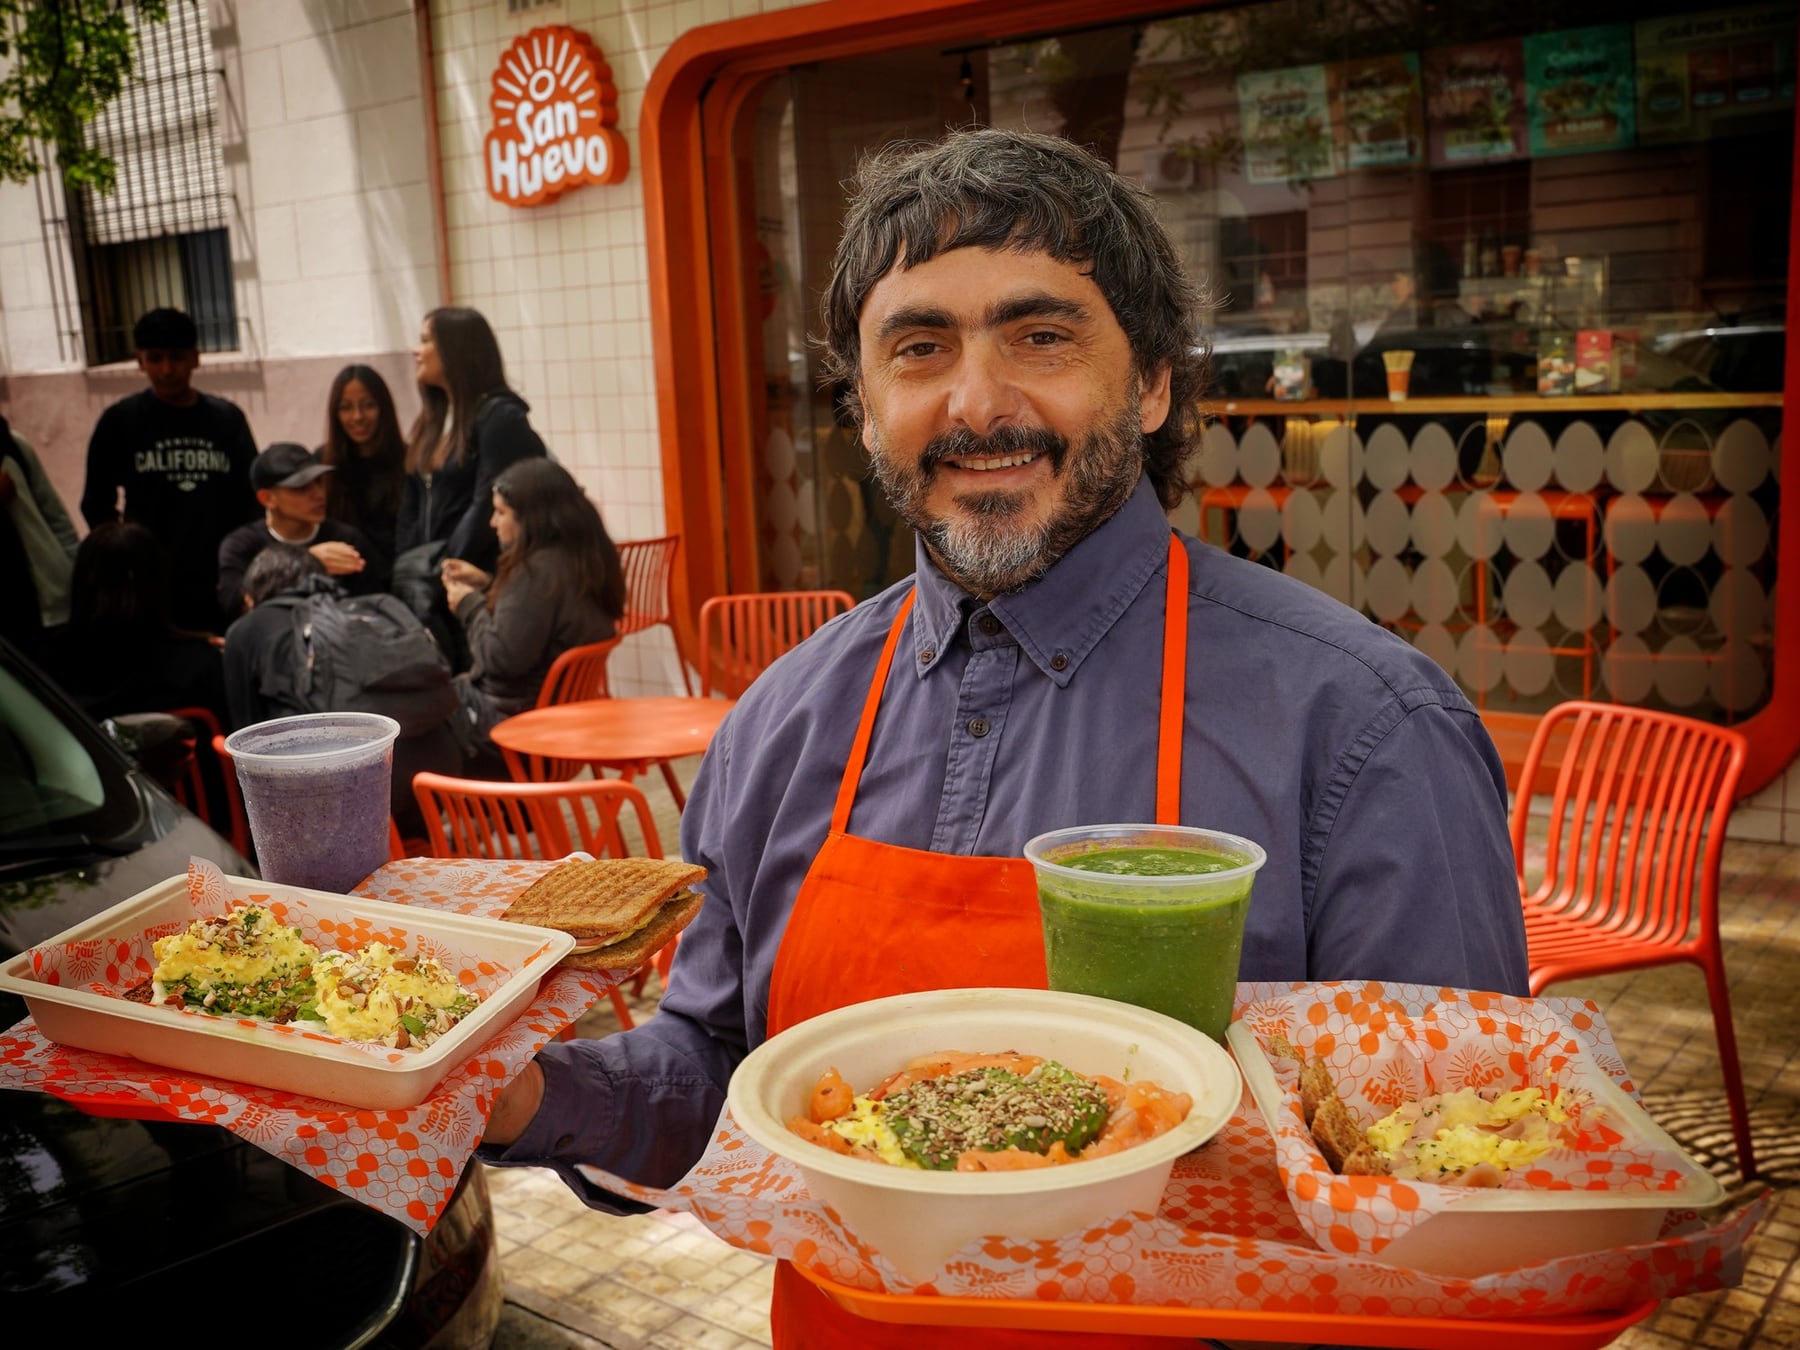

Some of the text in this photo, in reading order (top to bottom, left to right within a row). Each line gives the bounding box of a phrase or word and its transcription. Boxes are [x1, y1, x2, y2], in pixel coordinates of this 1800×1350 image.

[516, 100, 578, 156] San
[490, 135, 608, 199] Huevo
[1169, 1172, 1222, 1181] uevo
